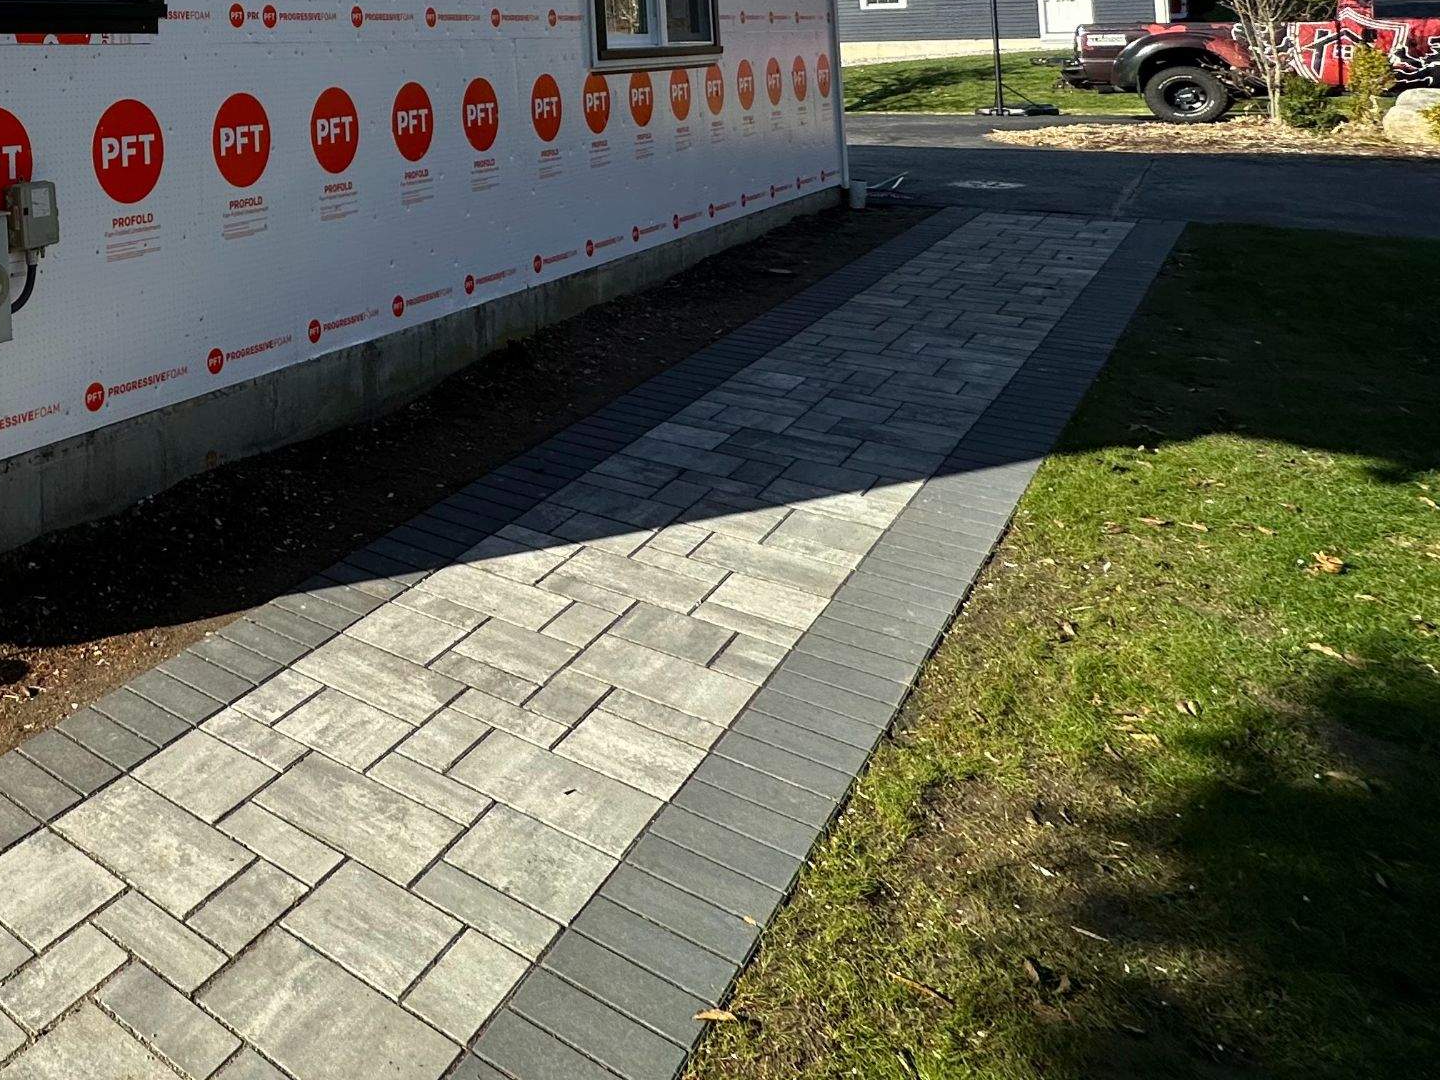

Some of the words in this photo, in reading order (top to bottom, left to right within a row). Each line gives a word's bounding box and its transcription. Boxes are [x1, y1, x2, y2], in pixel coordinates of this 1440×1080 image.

[231, 11, 244, 21] PFT
[263, 11, 277, 21] PFT
[279, 12, 337, 21] PROGRESSIVEFOAM
[364, 12, 414, 22] PROGRESSIVEFOAM
[631, 87, 650, 108] PFT
[671, 83, 688, 101] PFT
[708, 80, 721, 98] PFT
[534, 97, 559, 119] PFT
[585, 91, 607, 113] PFT
[397, 108, 429, 136] PFT
[466, 102, 495, 127] PFT
[220, 124, 264, 157] PFT
[317, 116, 353, 146] PFT
[101, 133, 155, 170] PFT
[404, 169, 429, 180] PROFOLD
[324, 181, 353, 195] PROFOLD
[229, 196, 263, 210] PROFOLD
[112, 213, 154, 229] PROFOLD
[405, 287, 453, 307] PROGRESSIVEFOAM
[309, 325, 320, 337] PFT
[323, 308, 379, 332] PROGRESSIVEFOAM
[209, 354, 222, 368] PFT
[226, 334, 292, 363] PROGRESSIVEFOAM
[86, 390, 103, 404] PFT
[108, 366, 188, 398] PROGRESSIVEFOAM
